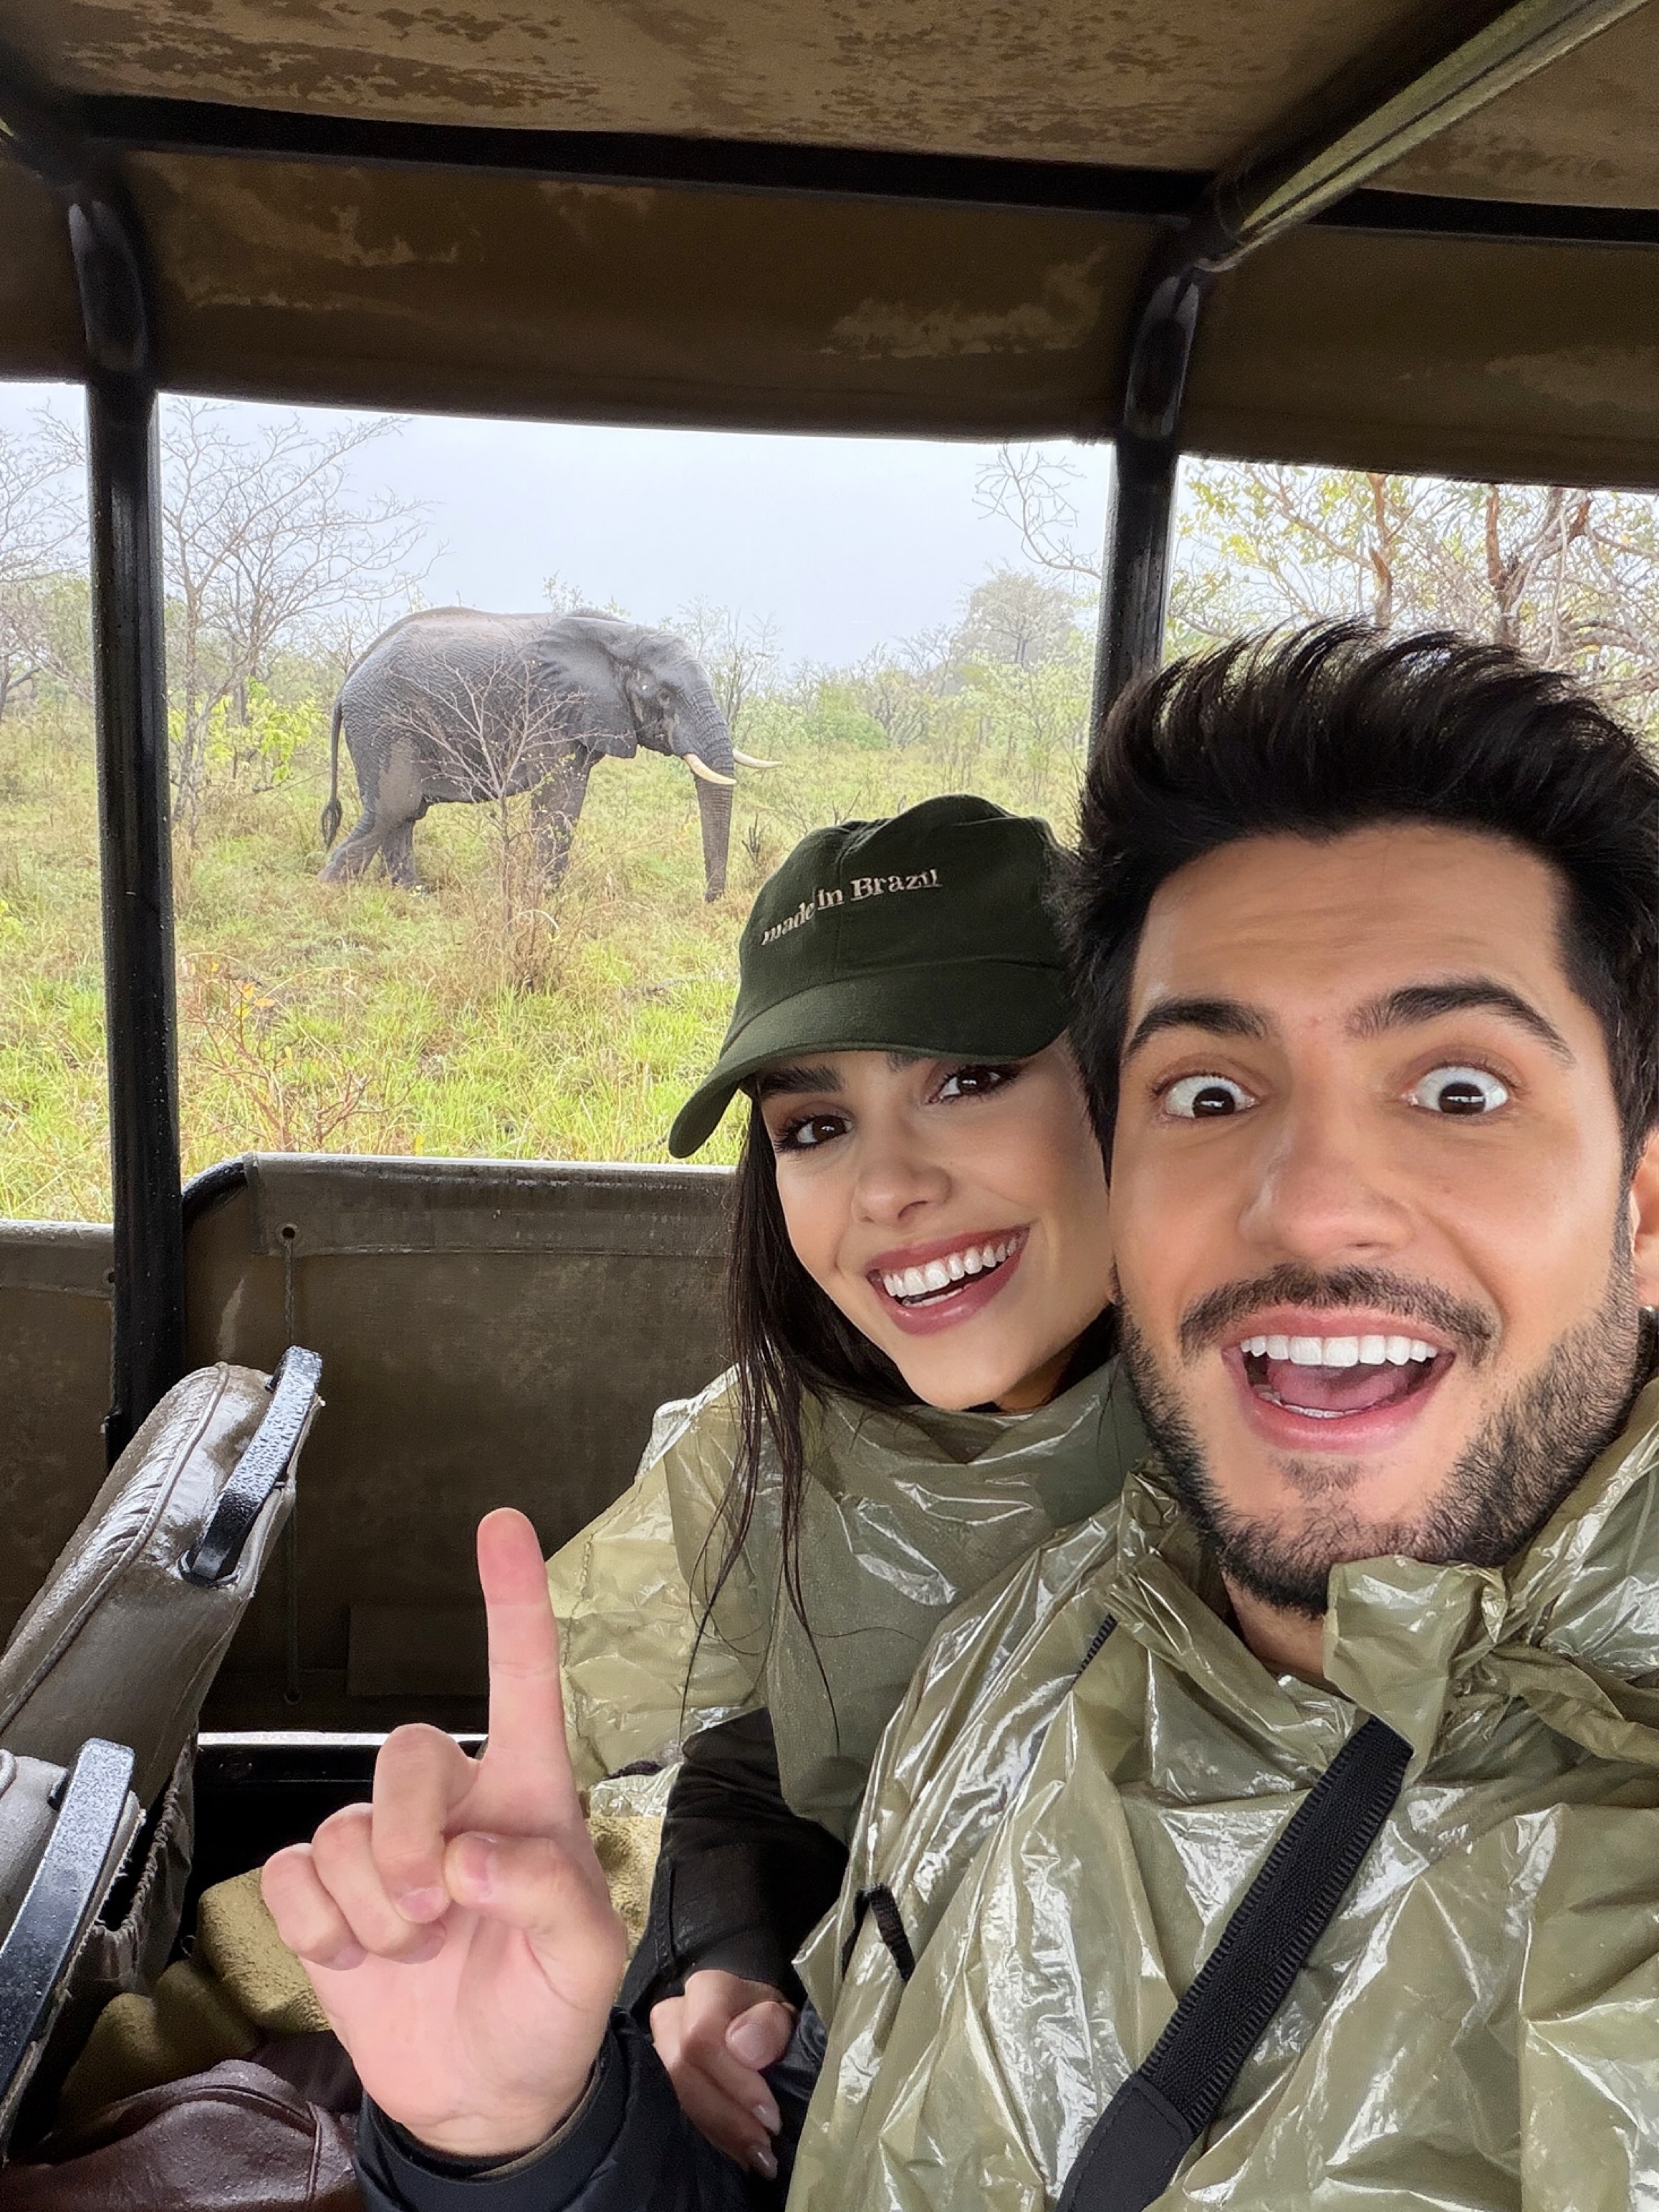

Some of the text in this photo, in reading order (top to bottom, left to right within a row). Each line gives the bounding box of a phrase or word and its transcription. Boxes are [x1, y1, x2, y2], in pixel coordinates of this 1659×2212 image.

[761, 868, 943, 946] made in Brazil
